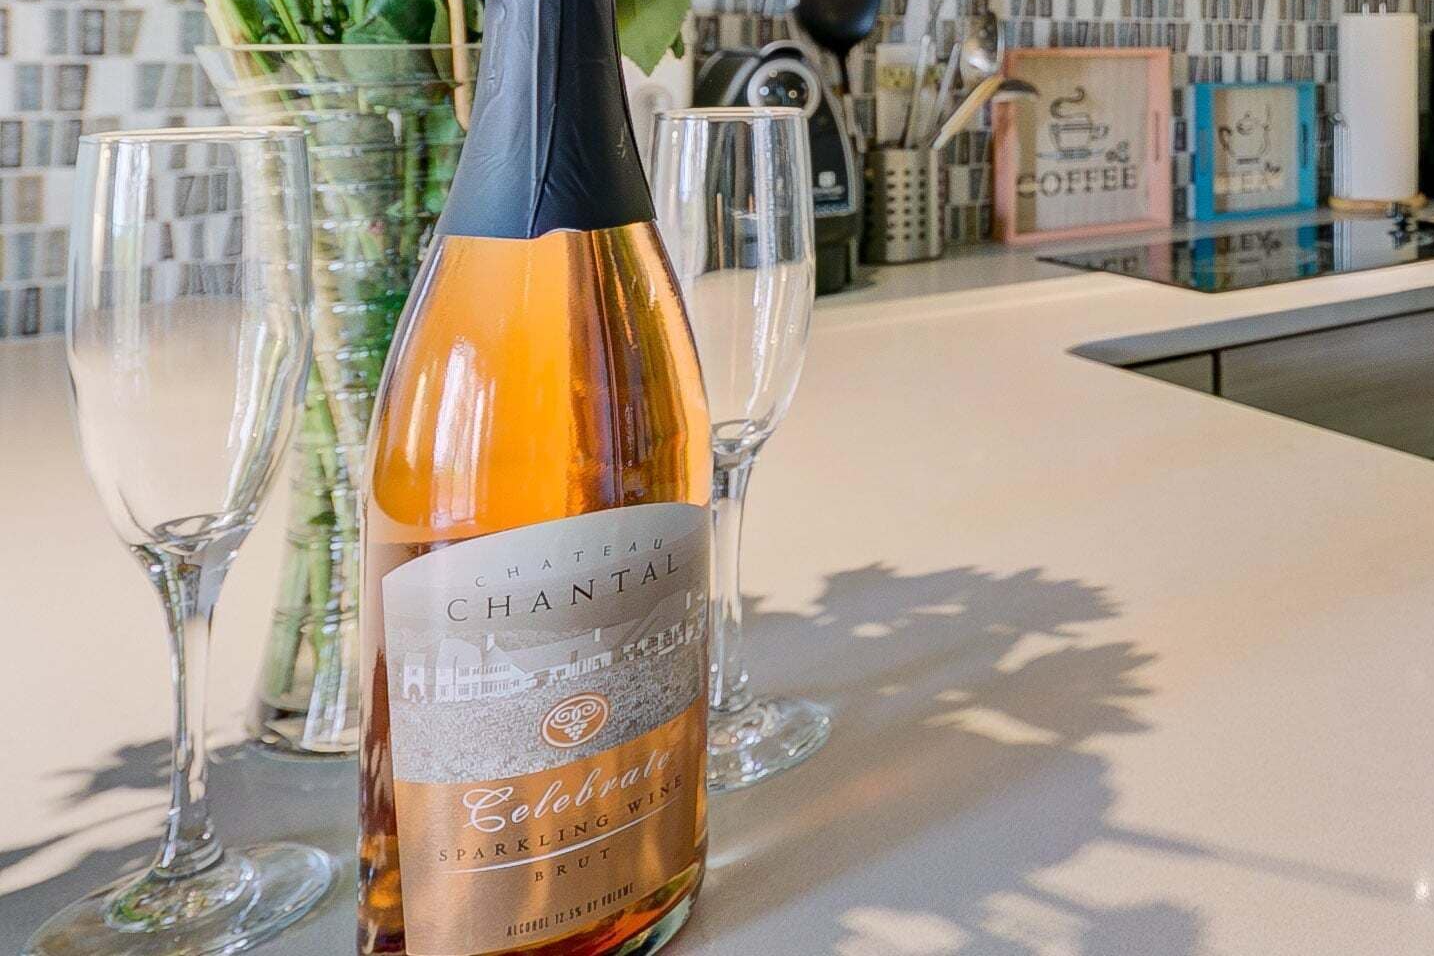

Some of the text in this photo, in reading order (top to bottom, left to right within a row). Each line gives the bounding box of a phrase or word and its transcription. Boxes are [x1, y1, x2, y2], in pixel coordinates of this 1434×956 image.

[1016, 164, 1137, 196] COFFEE
[447, 553, 680, 622] CHANTAL
[475, 538, 663, 588] CHATEAU
[439, 774, 683, 862] SPARKLING WINE
[462, 748, 672, 833] Celebrate
[534, 846, 611, 883] BRUT
[506, 916, 549, 937] ALCOHOL
[586, 900, 598, 913] BY
[601, 882, 634, 906] VOLUME
